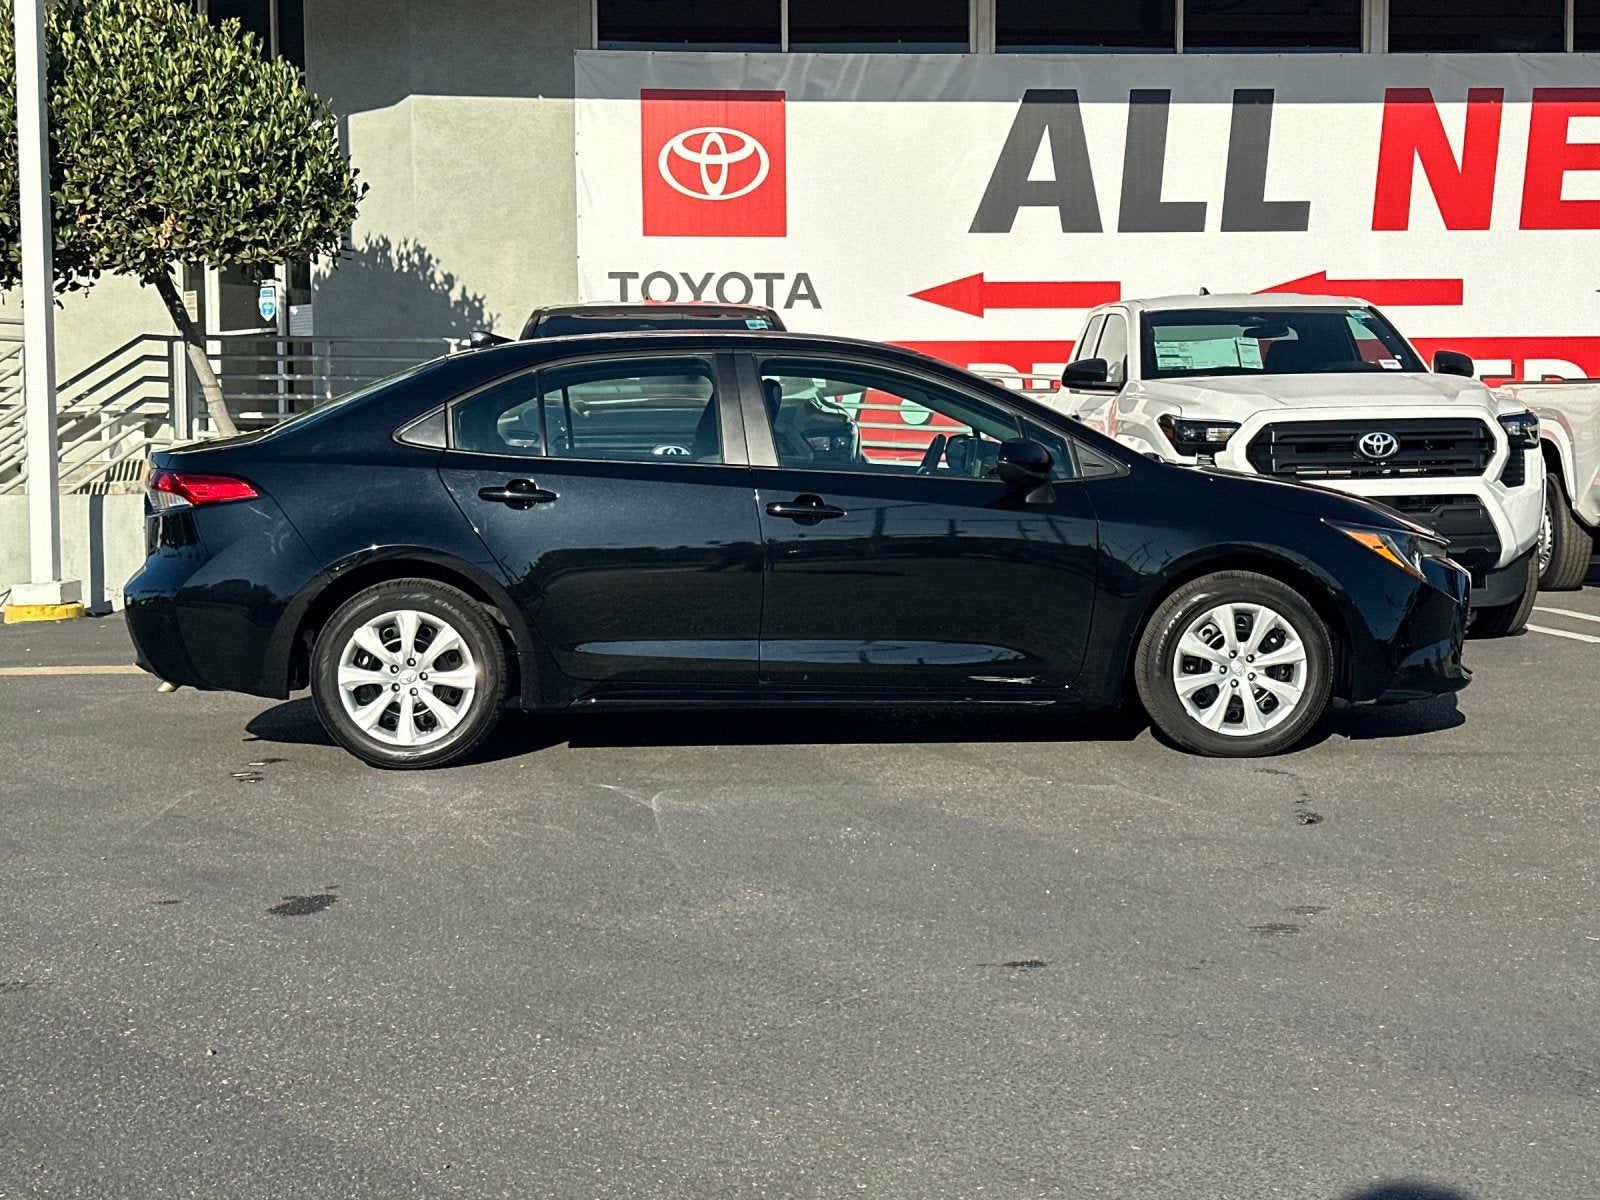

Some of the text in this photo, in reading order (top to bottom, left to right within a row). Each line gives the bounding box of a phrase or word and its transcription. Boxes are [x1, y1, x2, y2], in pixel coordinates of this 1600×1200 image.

[968, 87, 1600, 233] ALL NE
[608, 271, 822, 309] TOYOTA
